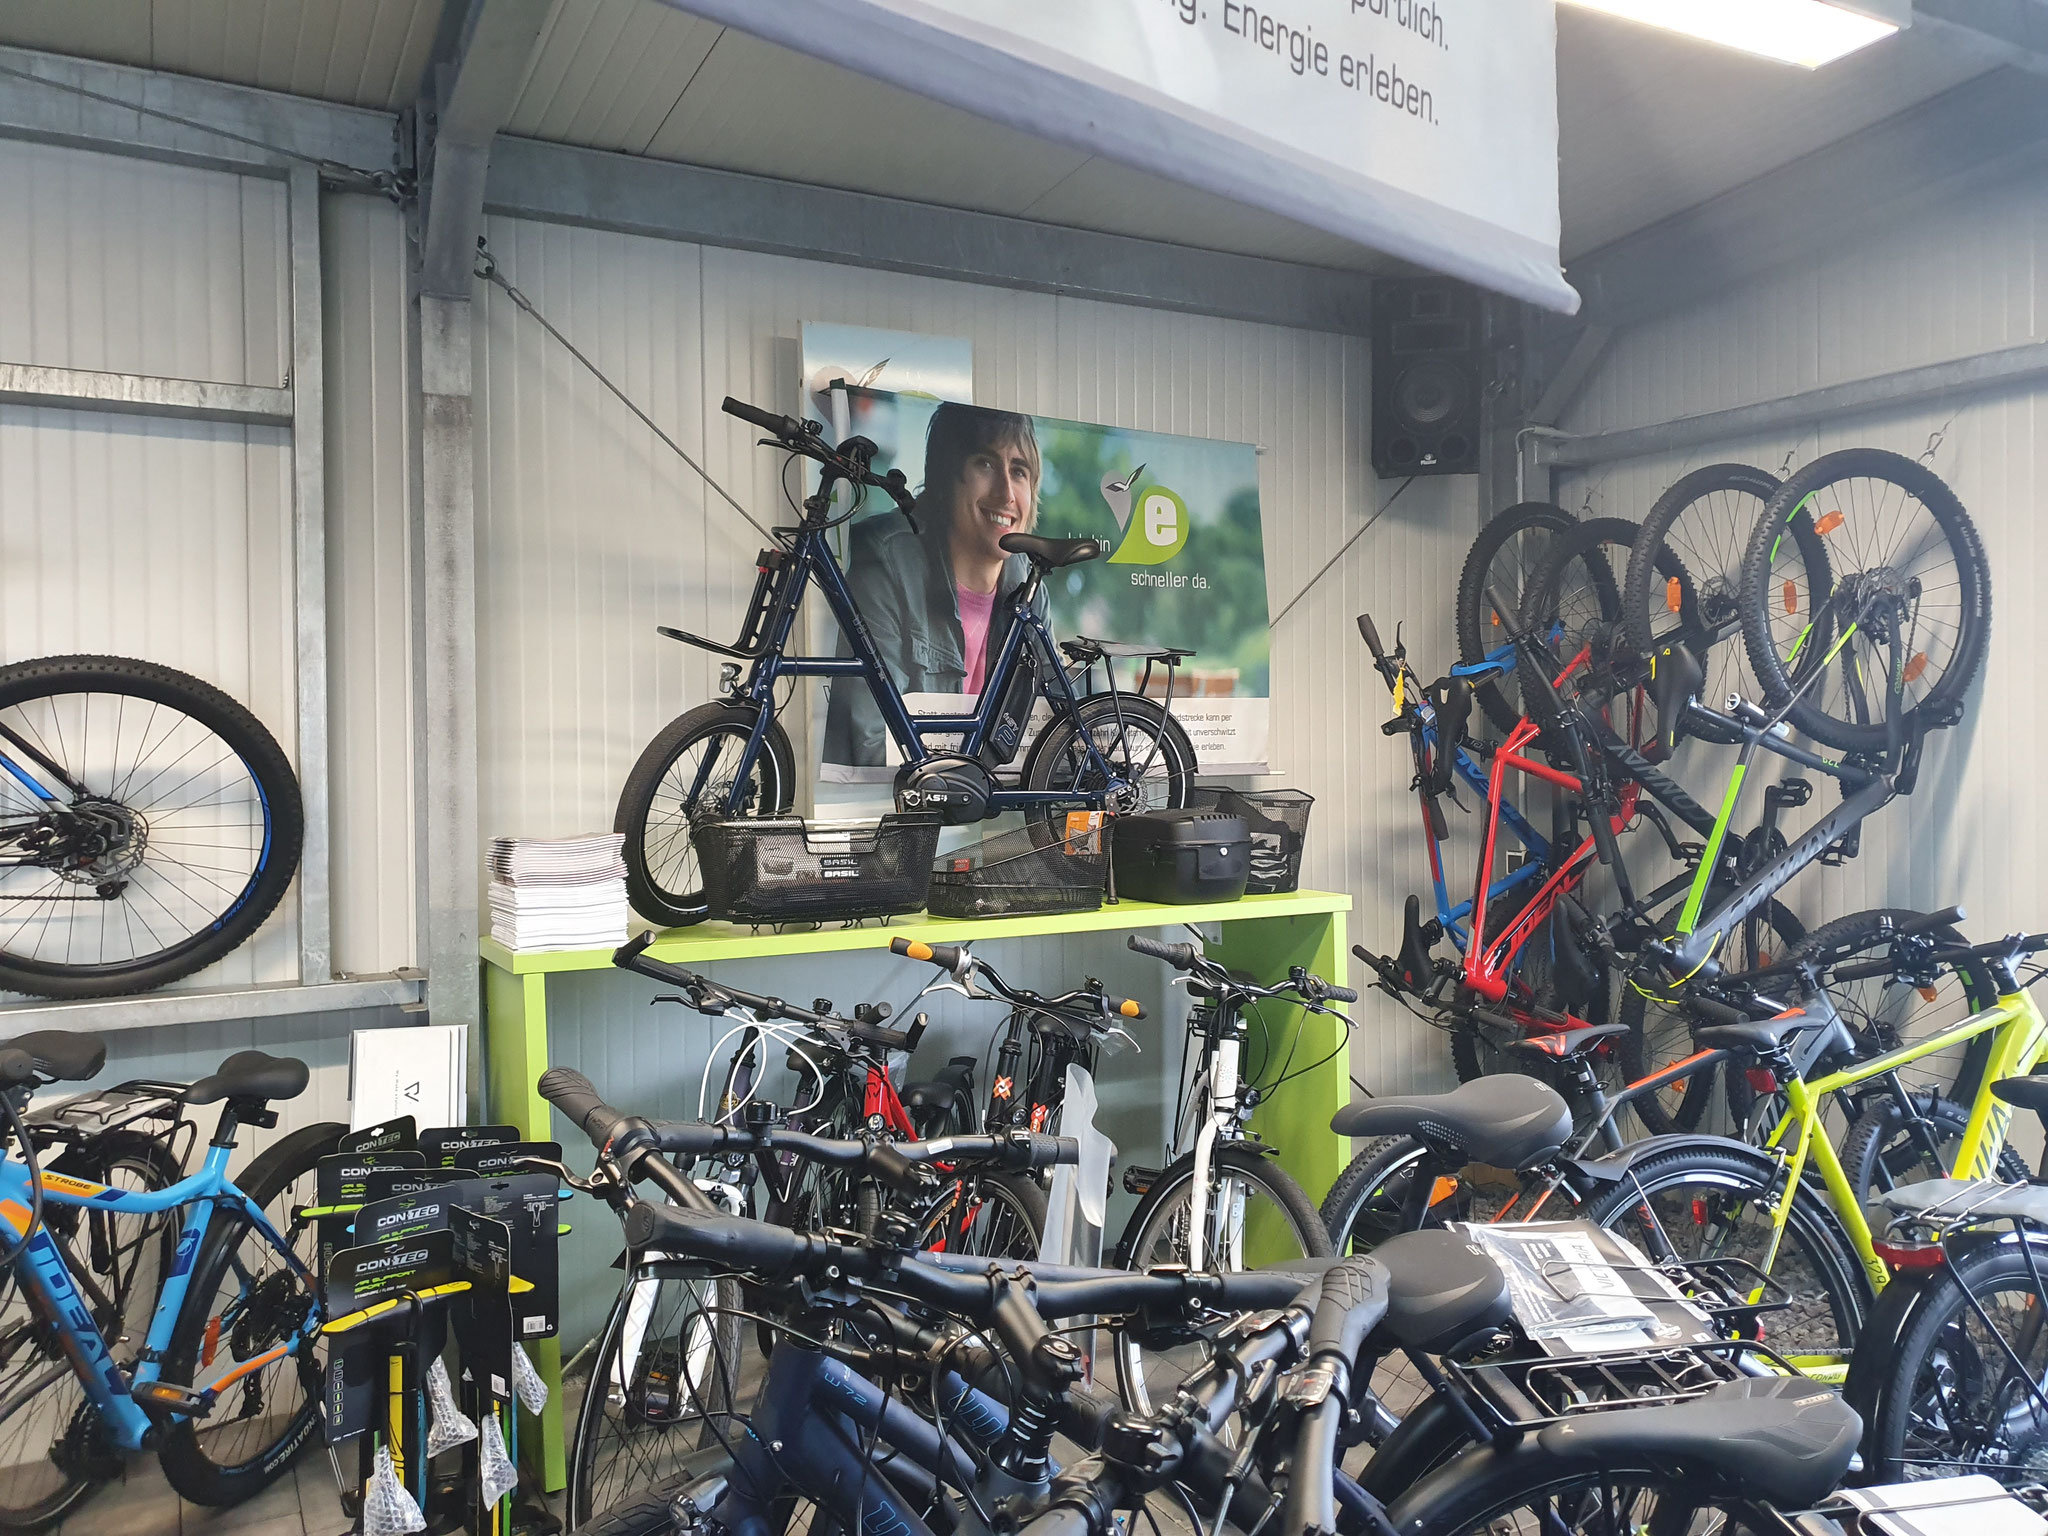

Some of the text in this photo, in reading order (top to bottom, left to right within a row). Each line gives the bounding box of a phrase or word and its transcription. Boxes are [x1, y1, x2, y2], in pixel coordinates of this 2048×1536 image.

[1223, 0, 1329, 76] Energie
[1340, 53, 1439, 126] erleben.
[1145, 494, 1178, 547] e
[1131, 570, 1211, 590] schneller da.
[824, 869, 859, 878] BASIL
[44, 1174, 92, 1190] STROBE
[377, 1203, 440, 1227] CONTEC
[356, 1249, 429, 1273] CONTEC
[1572, 1244, 1616, 1289] VICTRIA
[28, 1242, 129, 1397] IDEAL
